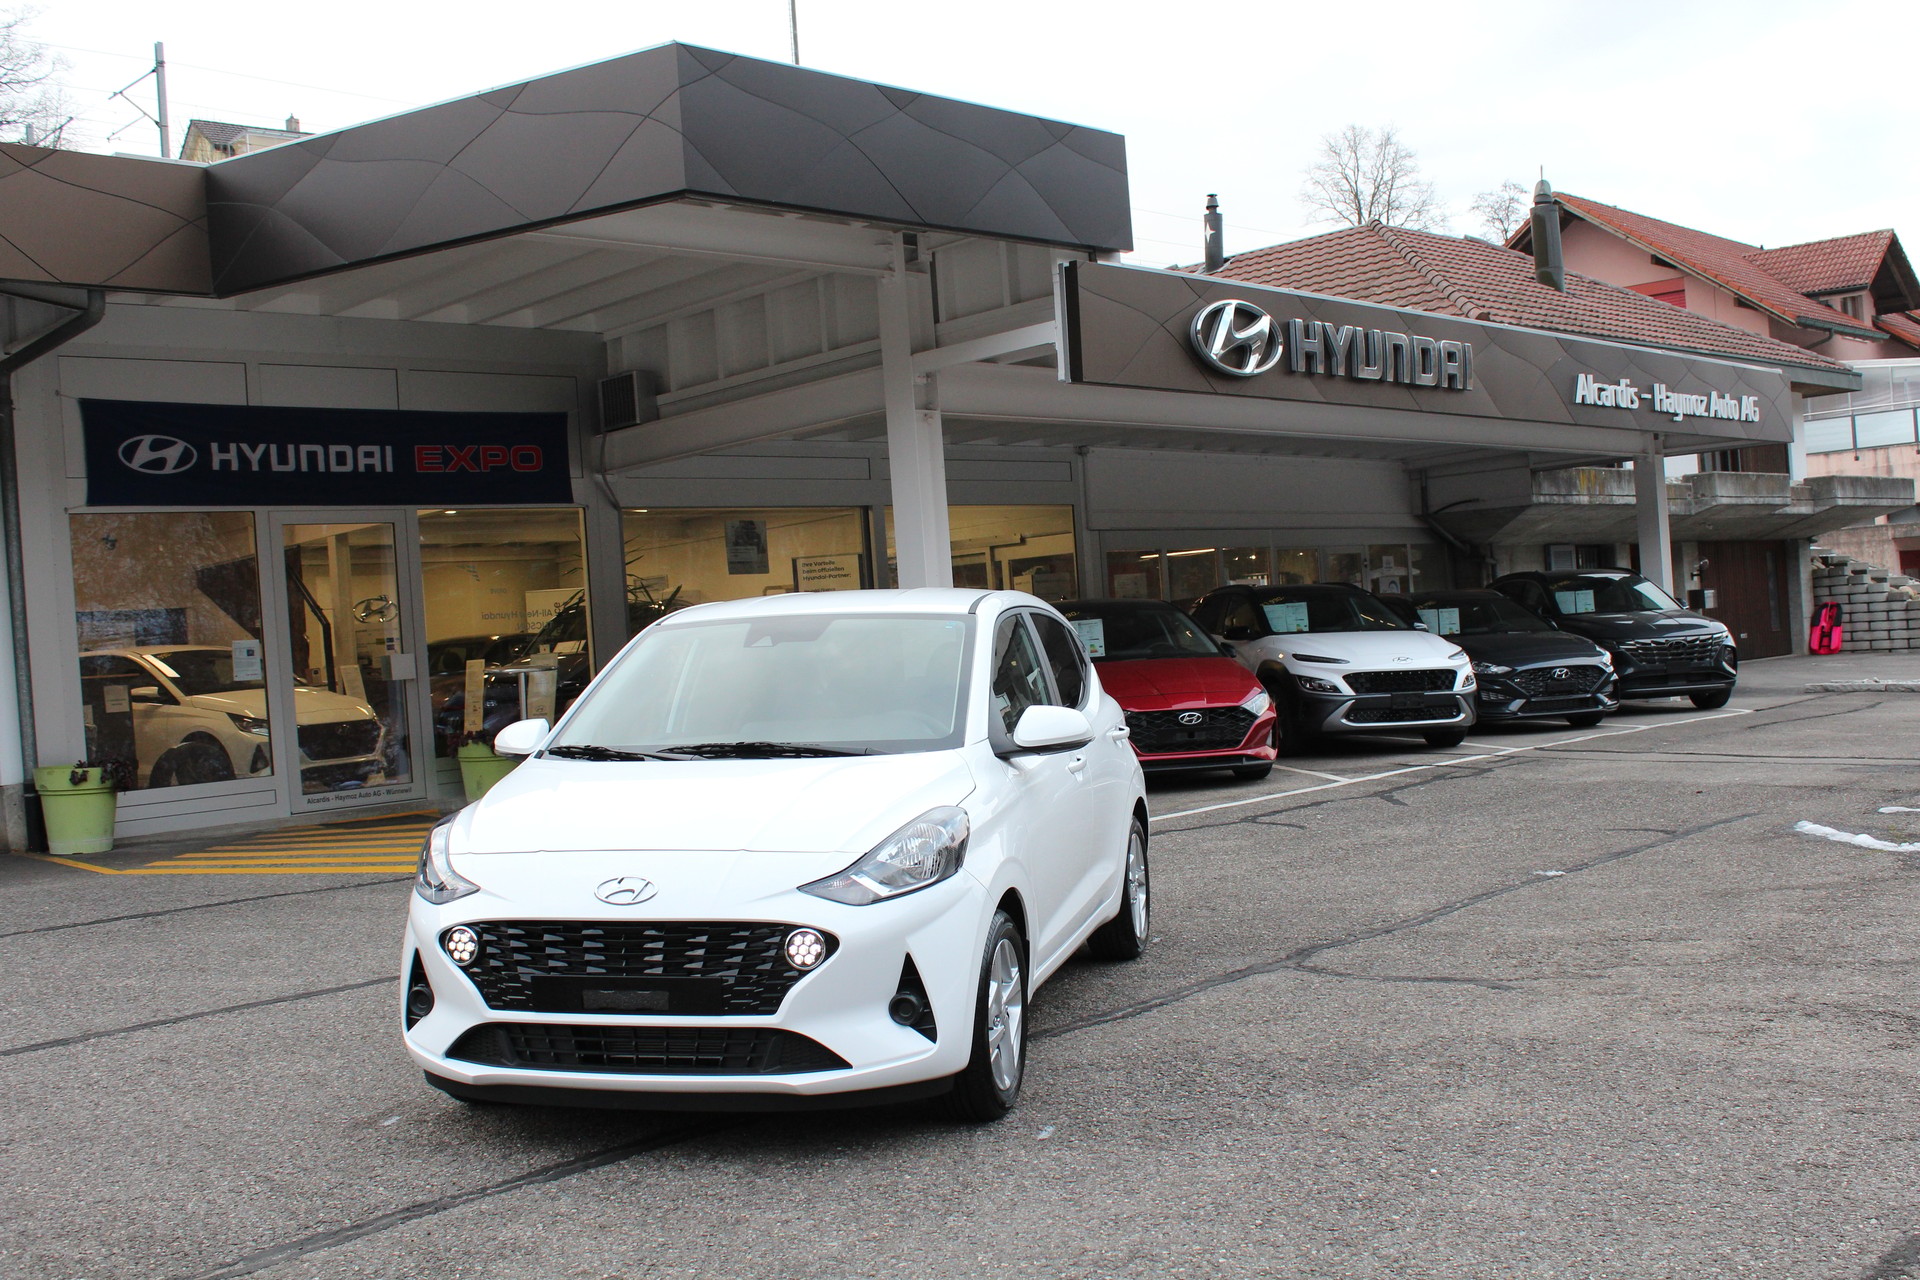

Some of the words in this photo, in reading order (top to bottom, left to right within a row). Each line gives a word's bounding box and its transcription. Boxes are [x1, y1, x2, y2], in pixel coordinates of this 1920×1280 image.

[1288, 318, 1474, 391] HYUNDAI
[1575, 373, 1640, 410] Alcardis
[1653, 383, 1709, 422] Haymoz
[1709, 390, 1739, 421] Auto
[1740, 395, 1760, 422] AG
[210, 442, 394, 473] HYUNDAI
[414, 444, 544, 473] EXPO
